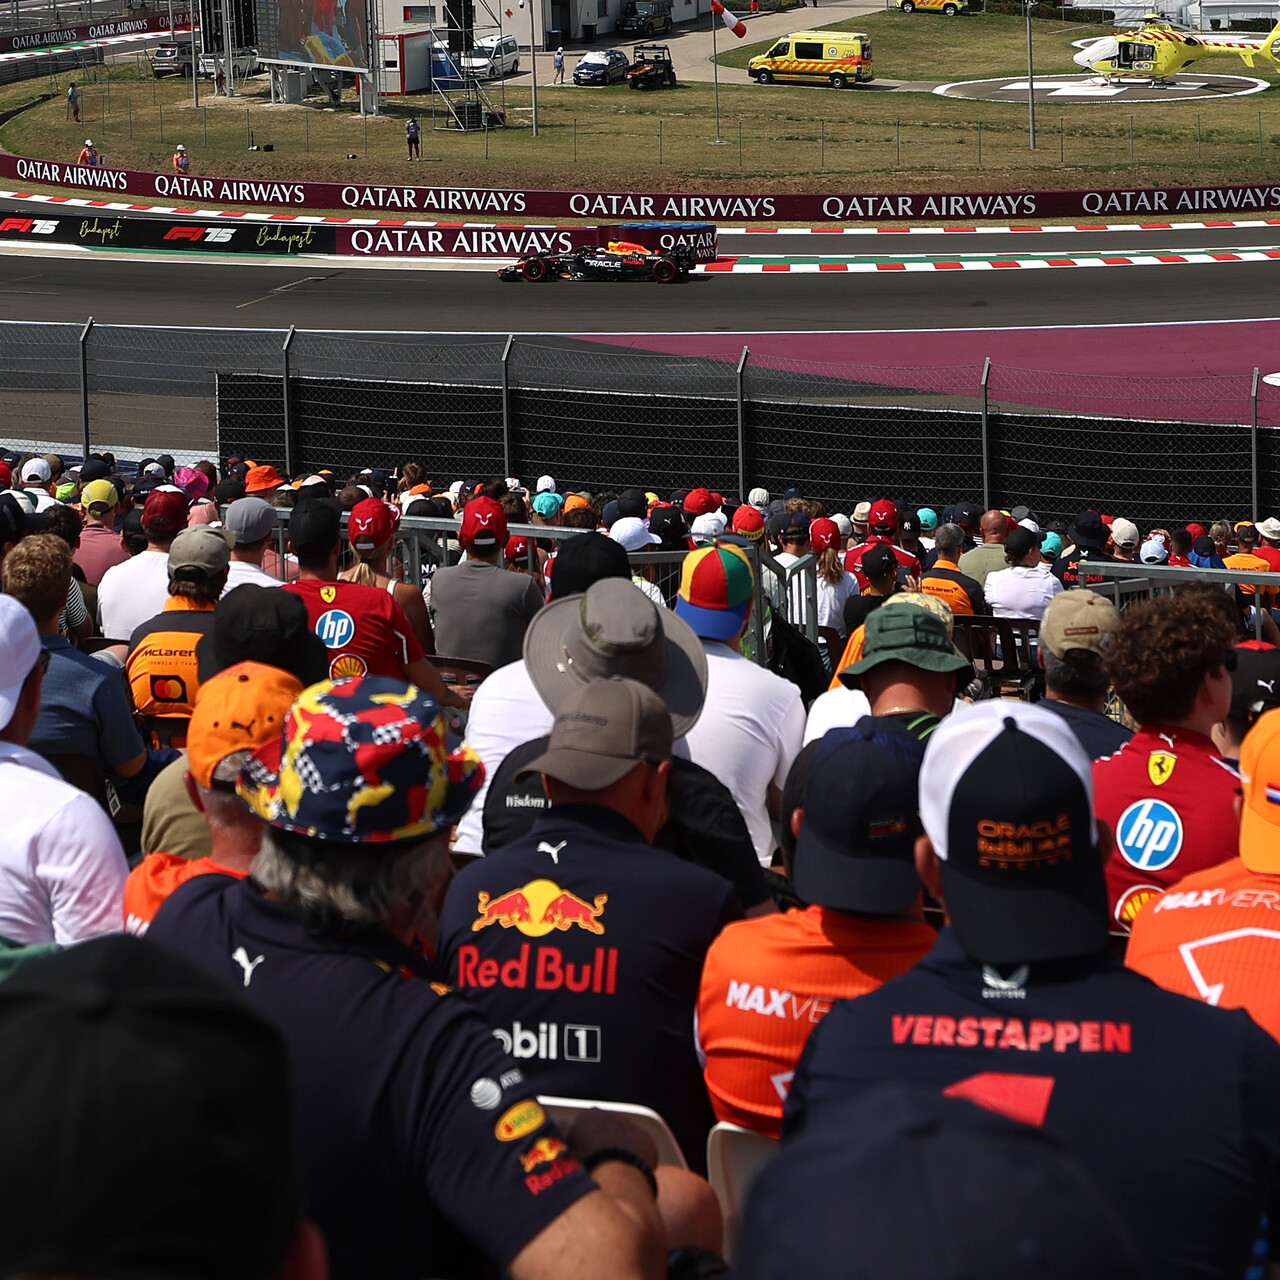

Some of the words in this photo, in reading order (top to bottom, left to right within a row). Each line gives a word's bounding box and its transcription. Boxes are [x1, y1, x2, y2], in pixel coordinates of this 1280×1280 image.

[89, 24, 116, 39] QATAR
[117, 19, 148, 34] AIRWAYS
[17, 159, 61, 182] QATAR
[63, 166, 128, 190] AIRWAYS
[155, 175, 215, 199] QATAR
[220, 181, 305, 203] AIRWAYS
[341, 186, 418, 210] QATAR
[423, 189, 526, 212] AIRWAYS
[570, 194, 656, 215] QATAR
[662, 197, 776, 217] AIRWAYS
[822, 196, 914, 219] QATAR
[921, 195, 1037, 216] AIRWAYS
[1081, 191, 1169, 215] QATAR
[30, 219, 60, 235] 75
[79, 217, 122, 244] Budapest
[203, 227, 238, 243] 75
[255, 223, 316, 253] Budapest
[351, 229, 445, 254] QATAR
[451, 230, 571, 255] AIRWAYS
[660, 232, 714, 249] QATAR
[584, 259, 621, 268] ORACLE
[922, 585, 954, 593] McLaren
[322, 610, 349, 647] hp
[143, 649, 197, 658] McLaren
[505, 794, 545, 808] Wisdom
[977, 813, 1070, 839] ORACLE
[1124, 800, 1176, 870] hp
[977, 837, 1003, 854] Red
[1005, 840, 1033, 856] Bull
[458, 941, 531, 989] Red
[535, 945, 618, 995] Bull
[891, 1014, 1132, 1055] VERSTAPPEN
